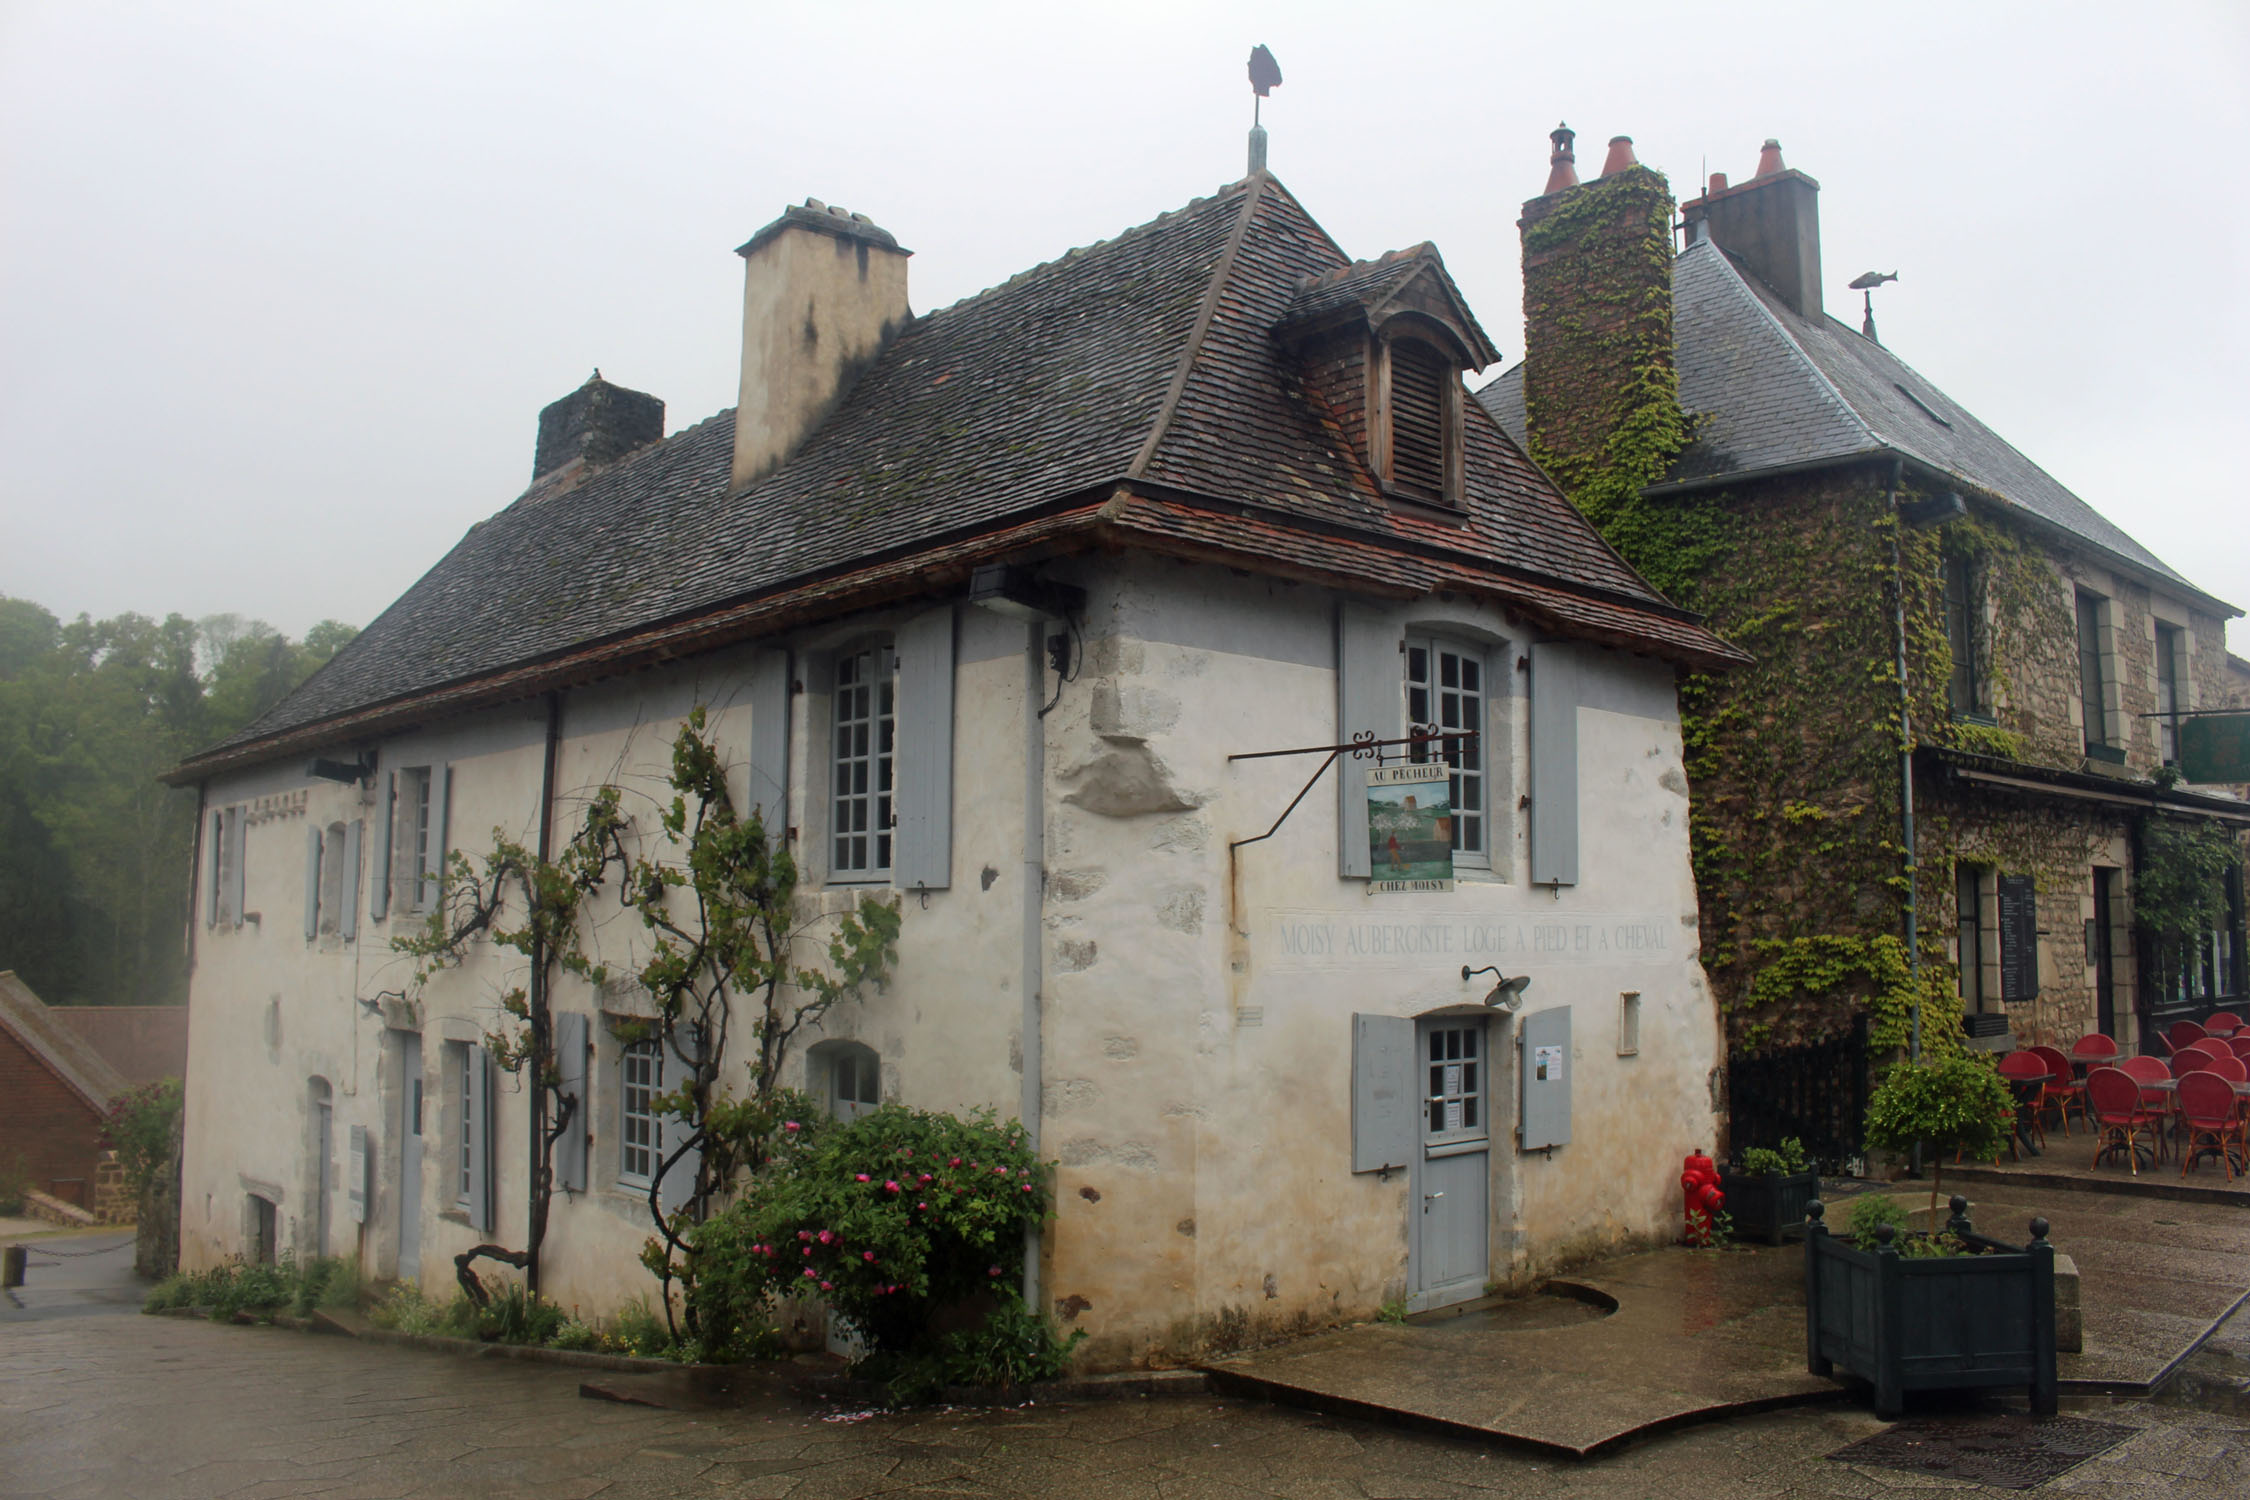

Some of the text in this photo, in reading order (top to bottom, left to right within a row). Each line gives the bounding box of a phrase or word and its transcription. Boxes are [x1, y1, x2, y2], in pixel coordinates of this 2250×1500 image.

[1373, 770, 1385, 781] AU
[1379, 881, 1407, 891] CHEZ
[1280, 924, 1336, 954] MOISY
[1346, 924, 1453, 954] AUBERGISTE
[1462, 925, 1507, 953] LOGE
[1533, 925, 1568, 951] PIED
[1575, 925, 1593, 951] ET
[1615, 924, 1668, 950] CHEVAL
